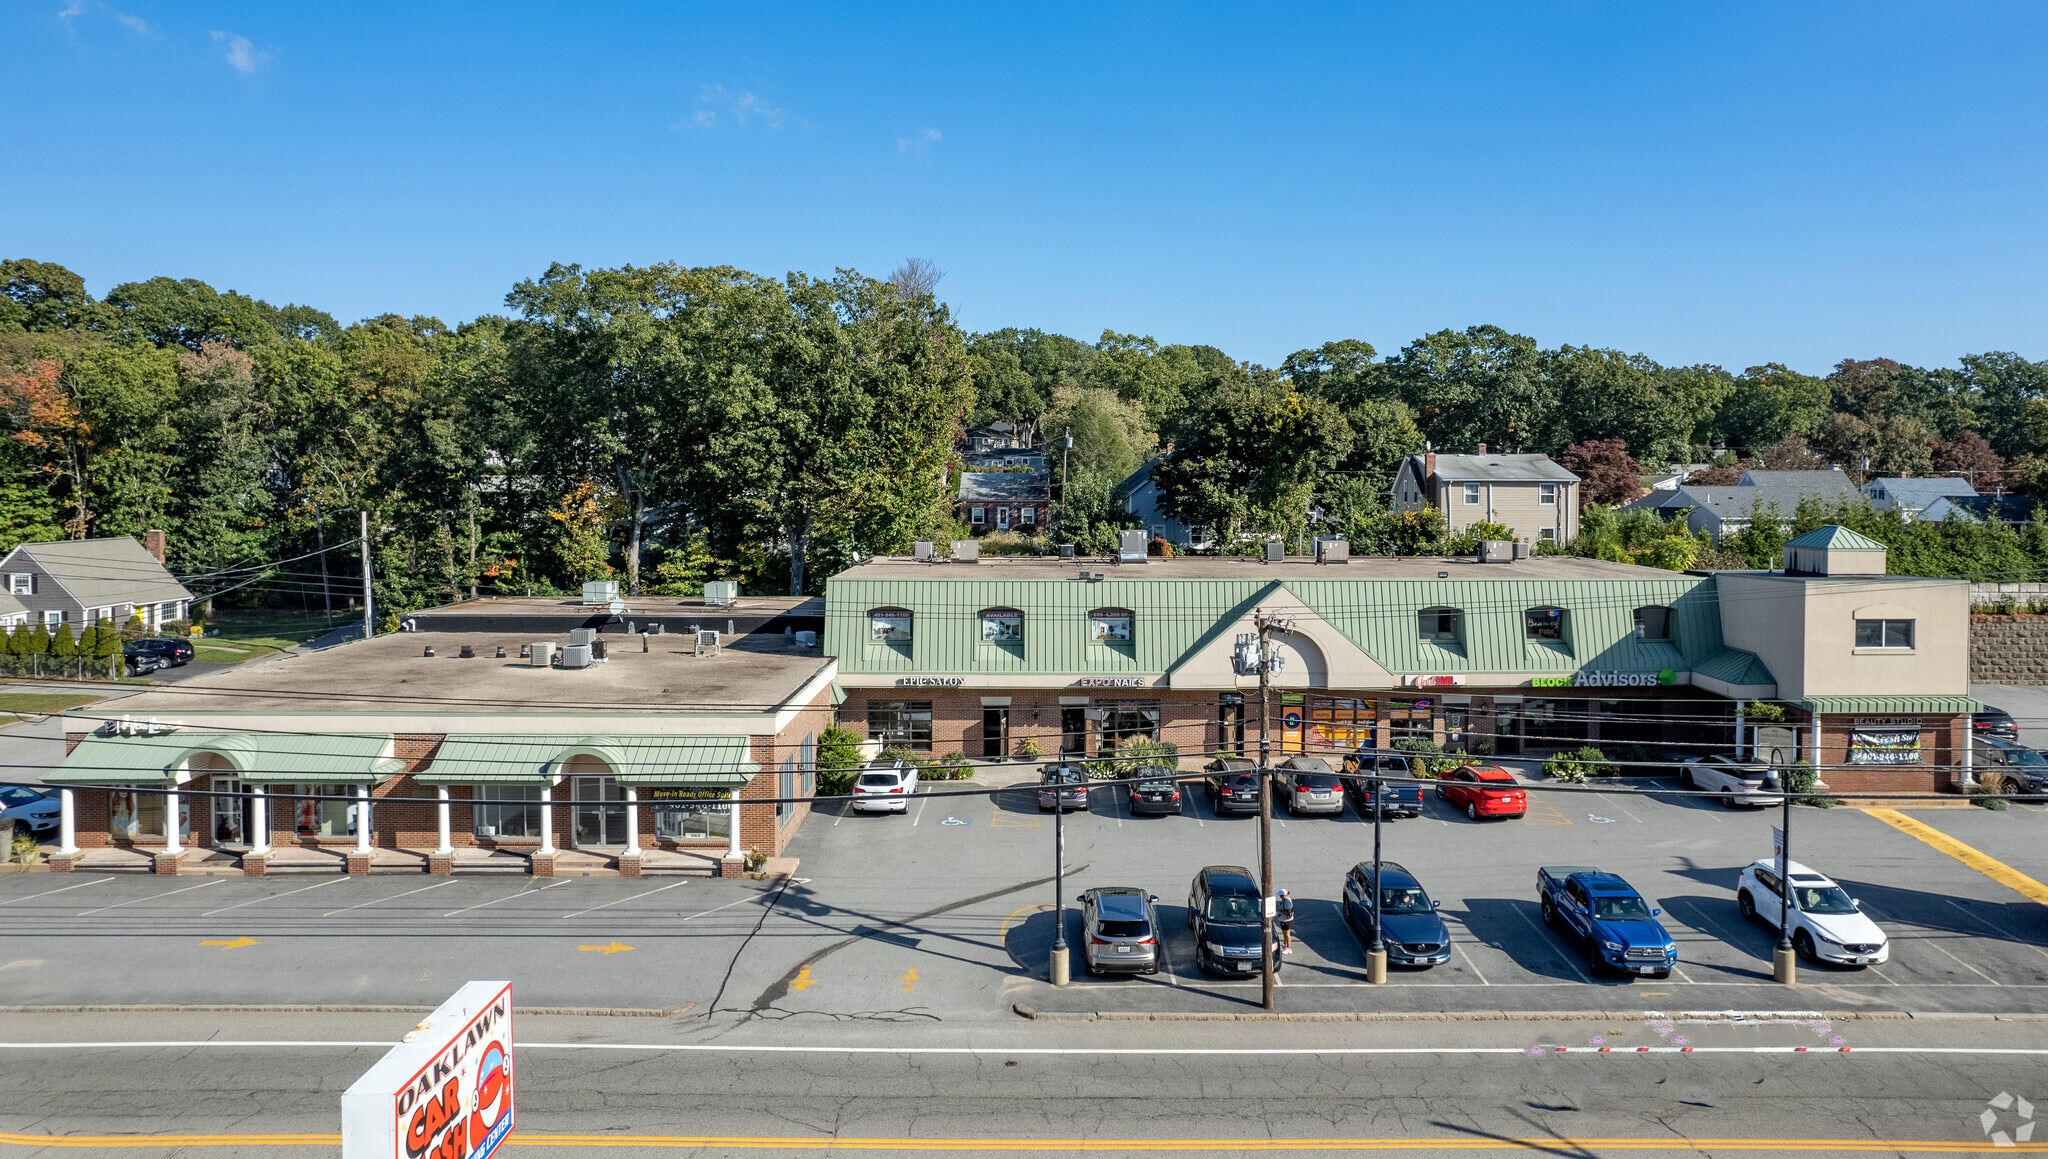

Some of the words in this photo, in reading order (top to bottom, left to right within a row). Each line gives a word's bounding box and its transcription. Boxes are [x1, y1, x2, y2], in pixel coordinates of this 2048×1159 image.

[903, 676, 927, 686] EPIC
[930, 676, 965, 686] SALON
[1081, 677, 1111, 687] EXPO
[1114, 677, 1145, 687] NAILS
[1532, 677, 1572, 687] BLOCK
[1574, 670, 1657, 687] Advisors
[678, 790, 697, 799] Ready
[697, 790, 716, 798] Office
[398, 997, 506, 1118] OAKLAWN
[406, 1076, 461, 1156] CAR
[486, 1112, 509, 1151] CENTER
